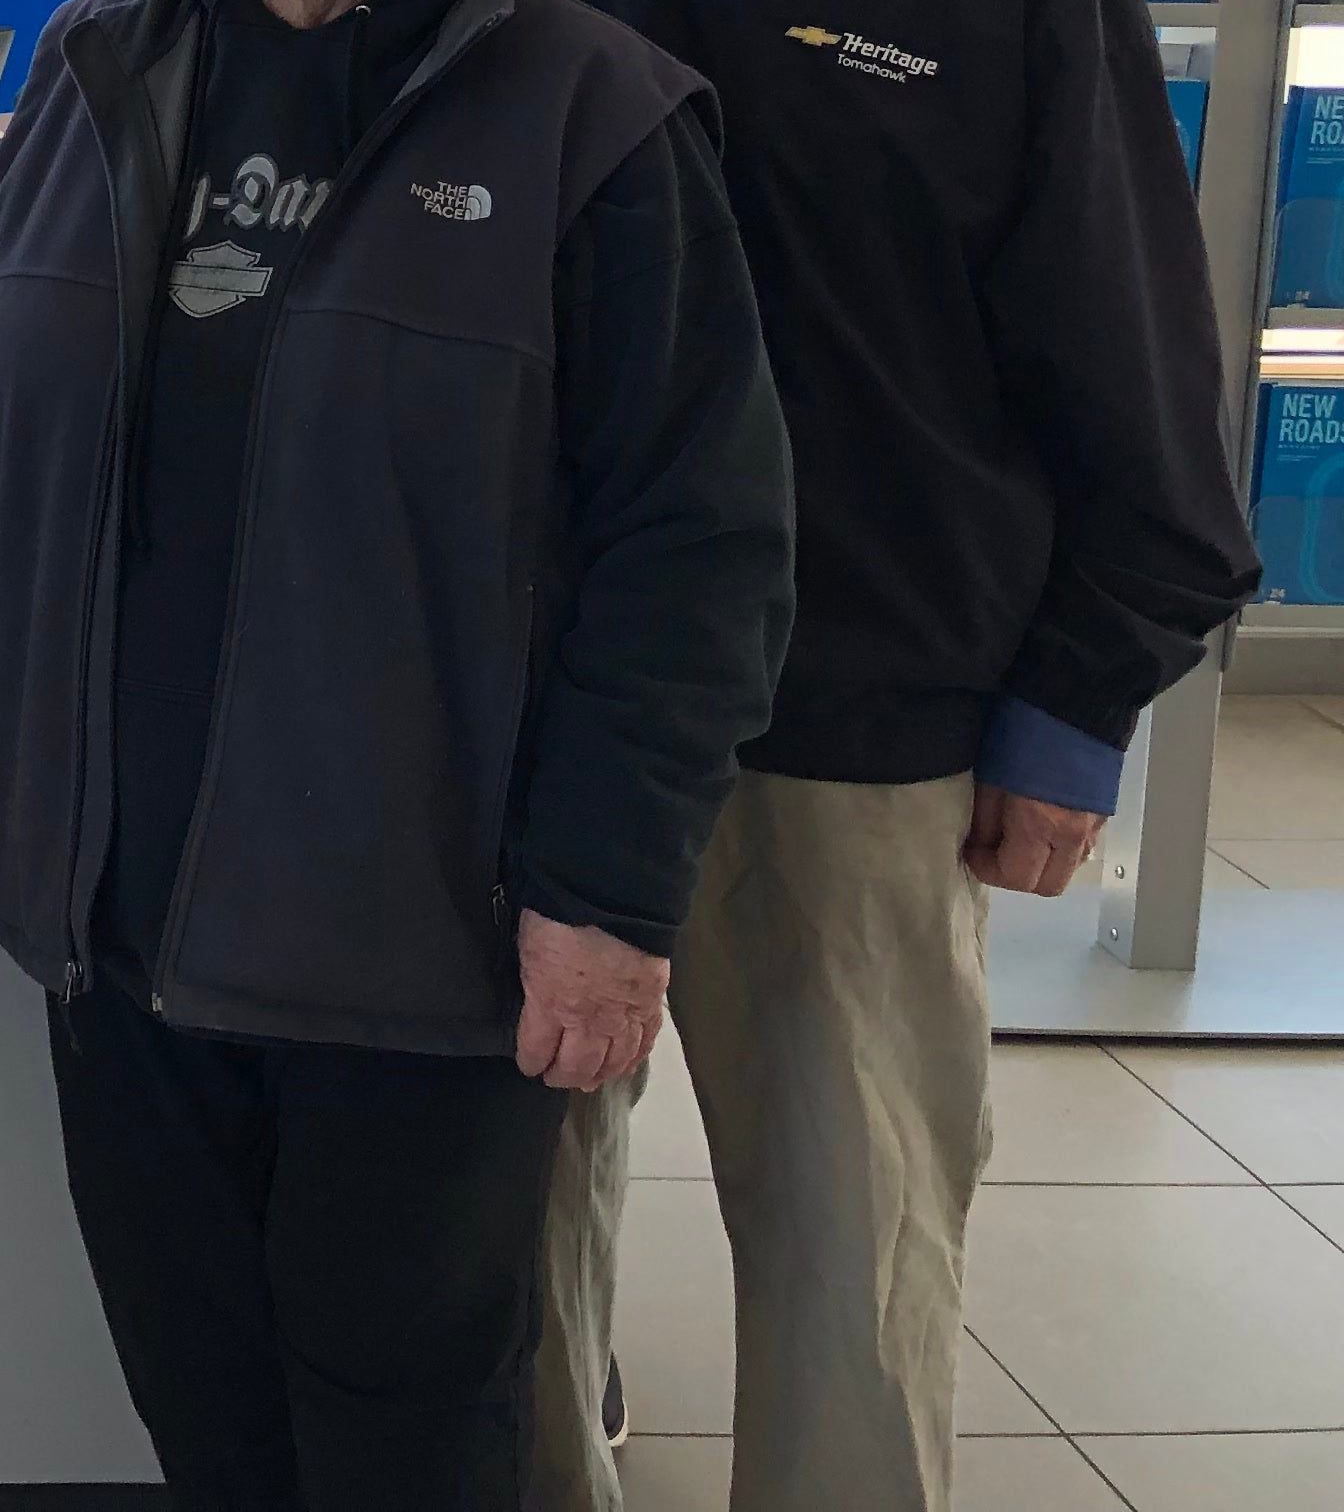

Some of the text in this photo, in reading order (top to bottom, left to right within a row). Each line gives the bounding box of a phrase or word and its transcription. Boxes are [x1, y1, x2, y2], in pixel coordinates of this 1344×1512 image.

[842, 32, 938, 76] Heritage
[837, 53, 907, 84] Tomahawk
[1314, 95, 1344, 120] NE
[1310, 120, 1344, 145] RO
[411, 183, 467, 208] NORTH
[437, 181, 468, 197] THE
[424, 200, 466, 221] FACE
[1282, 393, 1337, 418] NEW
